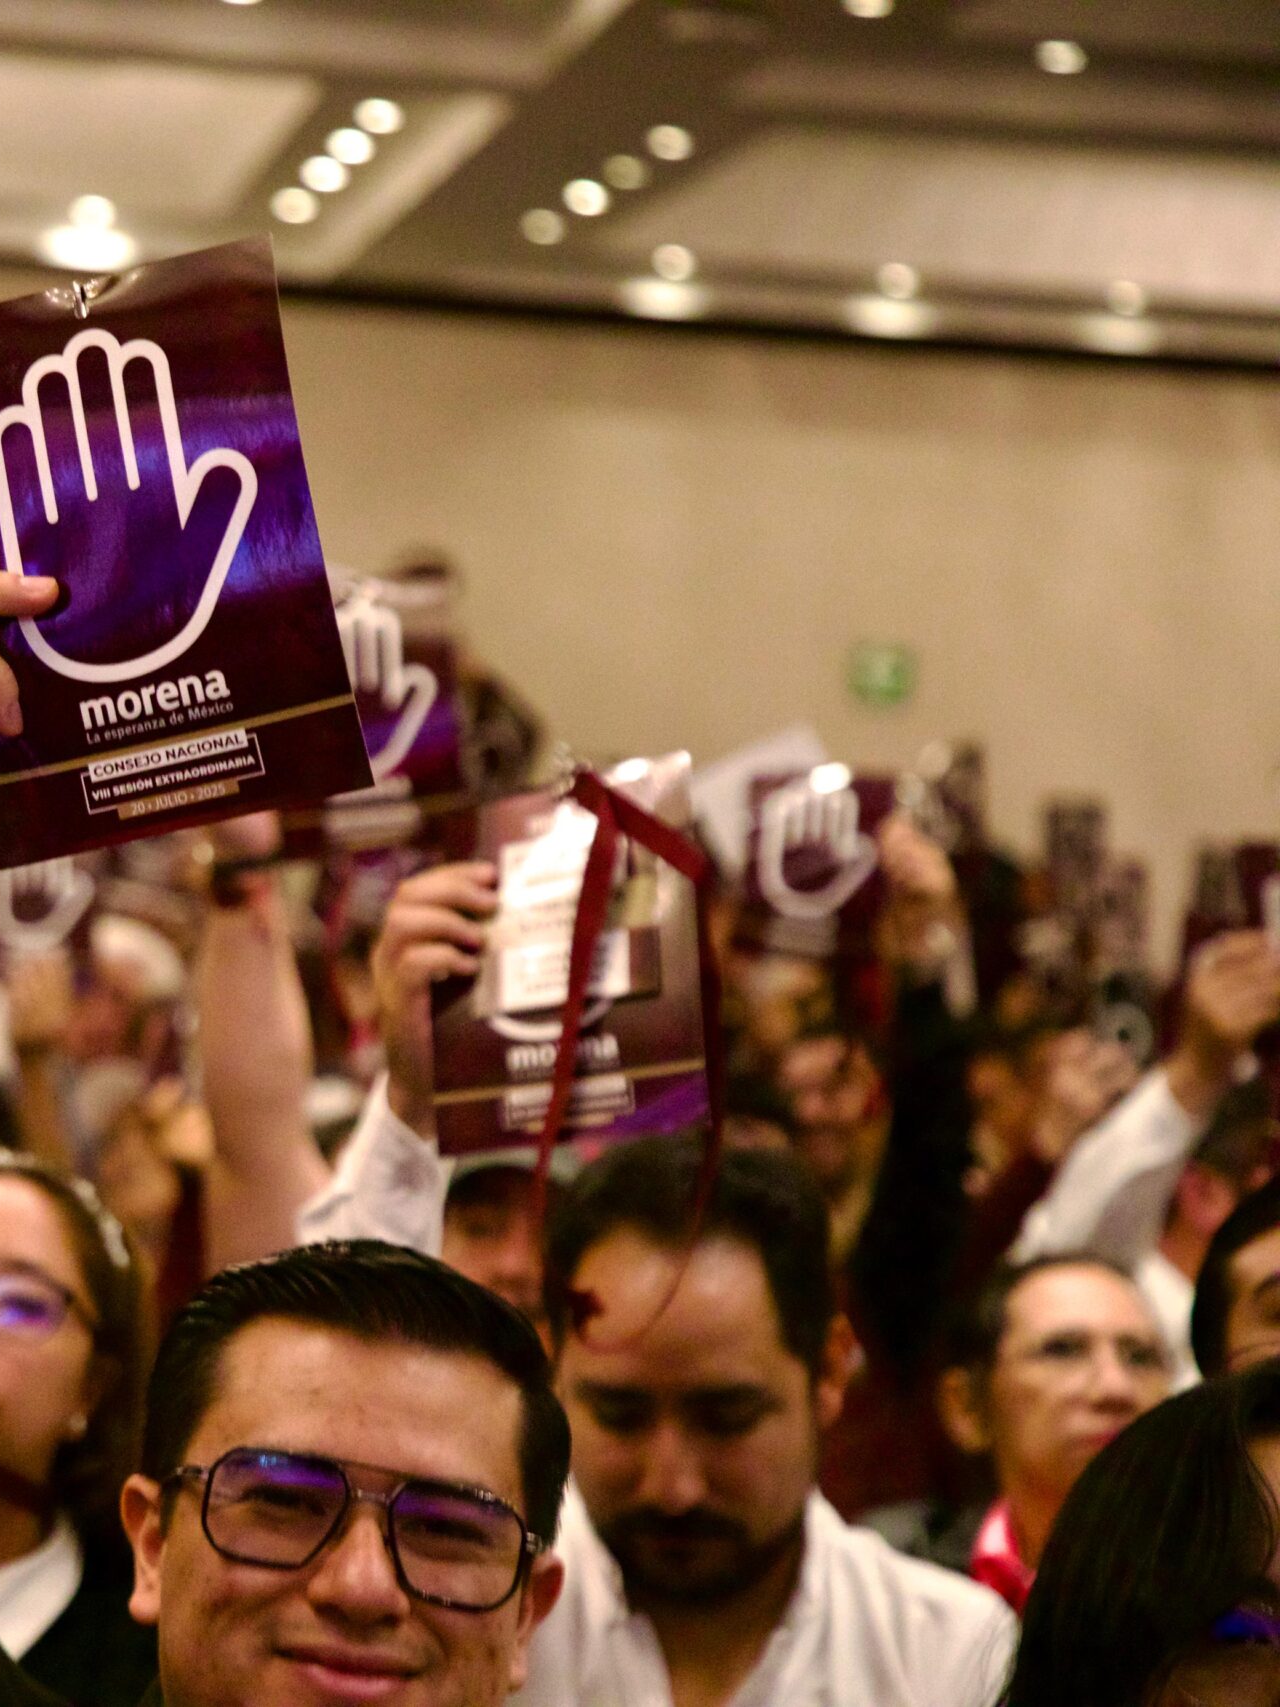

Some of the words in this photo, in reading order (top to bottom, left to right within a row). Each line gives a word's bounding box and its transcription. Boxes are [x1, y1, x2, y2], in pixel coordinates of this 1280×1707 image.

[79, 669, 231, 730] morena
[86, 732, 101, 745] La
[104, 718, 166, 740] esperanza
[170, 712, 184, 726] de
[188, 702, 234, 721] México
[93, 751, 161, 777] CONSEJO
[165, 733, 245, 760] NACIONAL
[91, 789, 111, 802] VIII
[113, 777, 153, 796] SESIÓN
[156, 754, 256, 786] EXTRAORDINARIA
[131, 802, 145, 815] 20
[154, 792, 187, 810] JULIO
[197, 783, 226, 800] 2025
